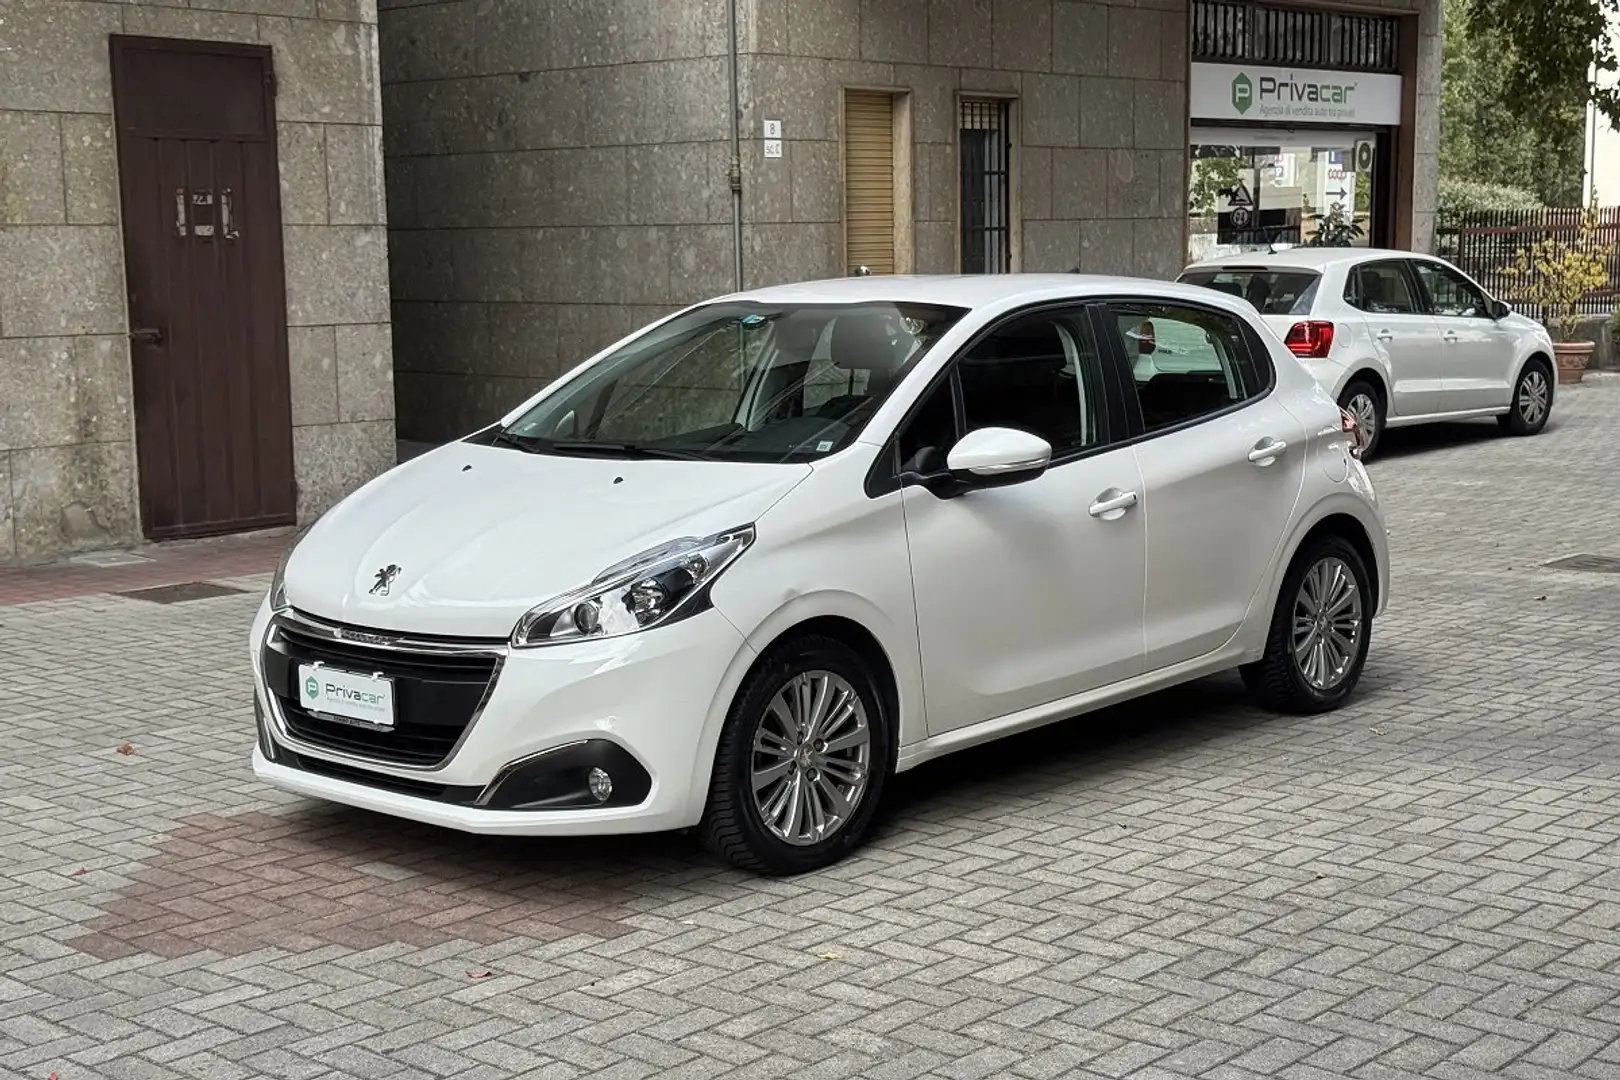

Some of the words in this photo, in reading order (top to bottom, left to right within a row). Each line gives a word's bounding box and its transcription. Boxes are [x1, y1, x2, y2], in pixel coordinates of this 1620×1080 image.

[1259, 74, 1355, 104] Privacar
[1259, 103, 1284, 117] Agenzia
[1292, 105, 1314, 117] vendita
[325, 682, 386, 704] Privacar
